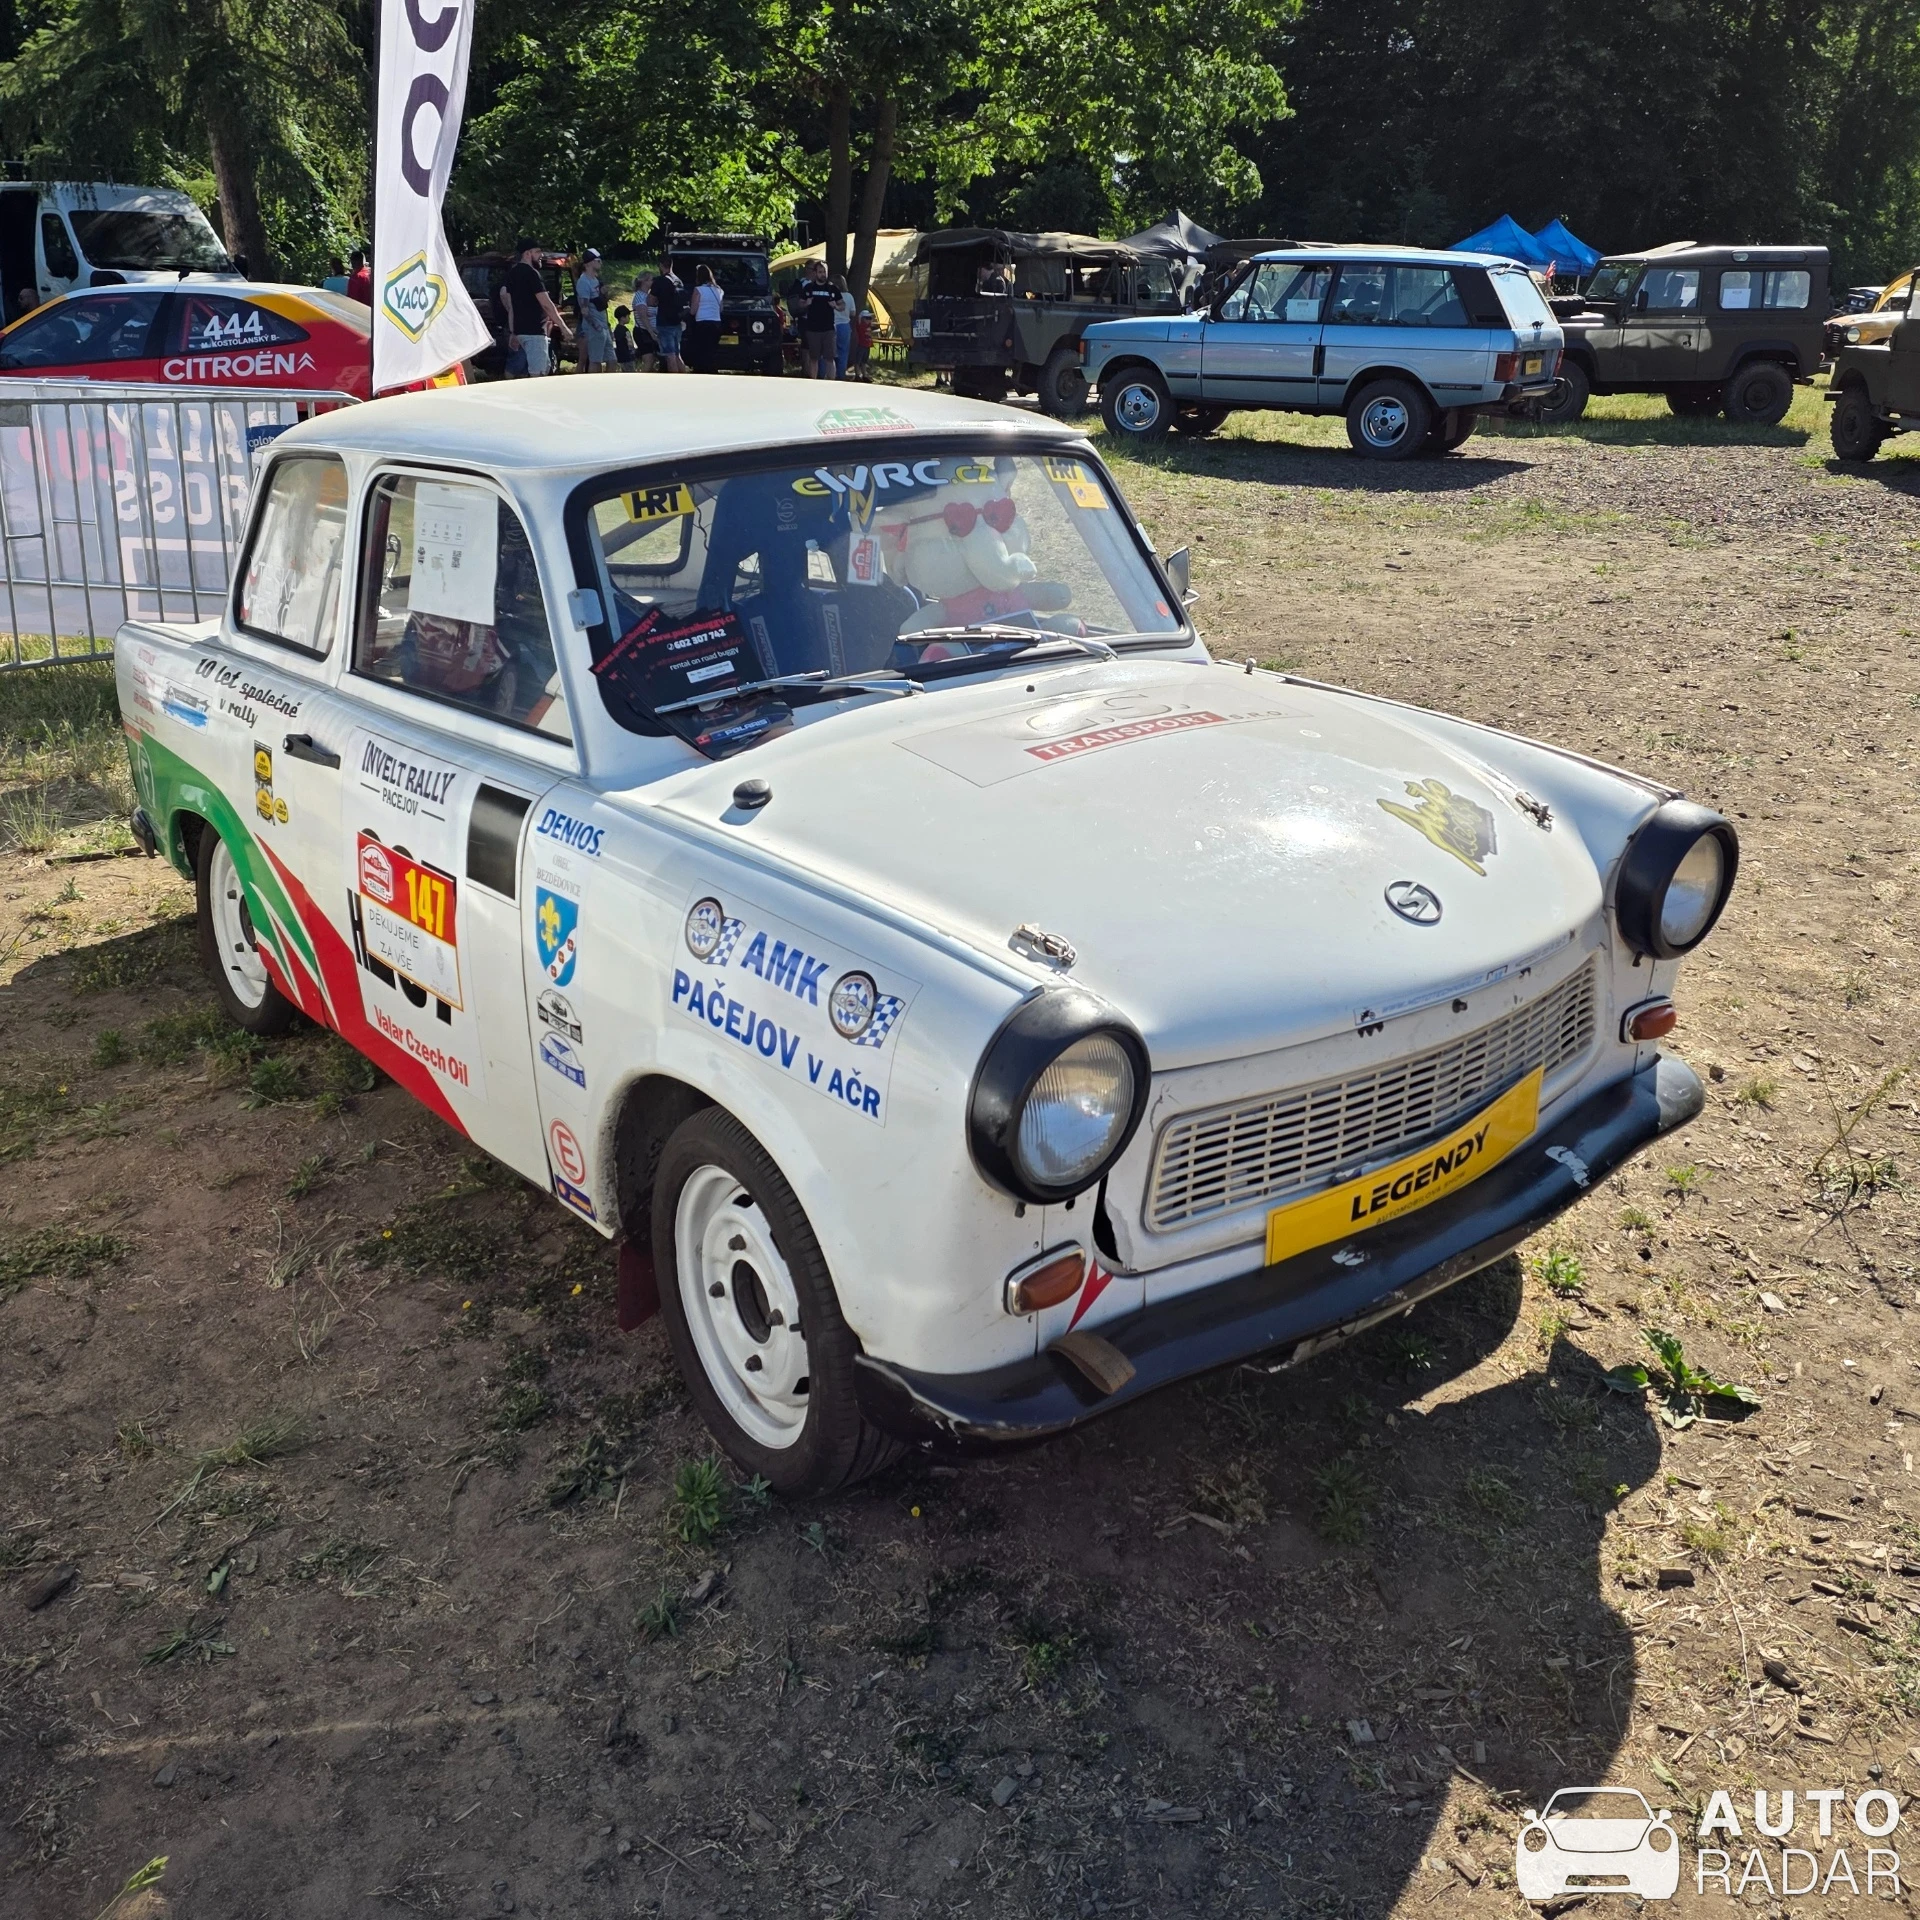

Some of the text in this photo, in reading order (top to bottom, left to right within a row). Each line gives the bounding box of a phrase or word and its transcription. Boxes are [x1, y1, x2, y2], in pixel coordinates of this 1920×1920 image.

[203, 311, 264, 341] 444
[163, 351, 296, 381] CITROËN
[815, 406, 903, 426] ASK
[1047, 456, 1078, 480] HRT
[631, 484, 682, 519] HRT
[674, 628, 727, 650] 602 307 742
[669, 659, 691, 671] rental
[691, 657, 701, 665] on
[700, 652, 717, 663] road
[717, 647, 739, 660] buggy
[195, 658, 303, 719] 10 let společně
[228, 702, 259, 729] rally
[724, 719, 768, 736] POLARIS
[1036, 712, 1211, 758] TRANSPORT
[361, 740, 457, 805] INVELT RALLY
[405, 868, 445, 938] 147
[369, 907, 420, 950] DĚKUJEME
[380, 940, 413, 972] ZA VŠE
[740, 931, 830, 1006] AMK
[374, 1004, 469, 1088] Valar Czech Oil
[672, 968, 801, 1069] PAČEJOV
[827, 1067, 881, 1119] AČR
[1351, 1122, 1490, 1222] LEGENDY
